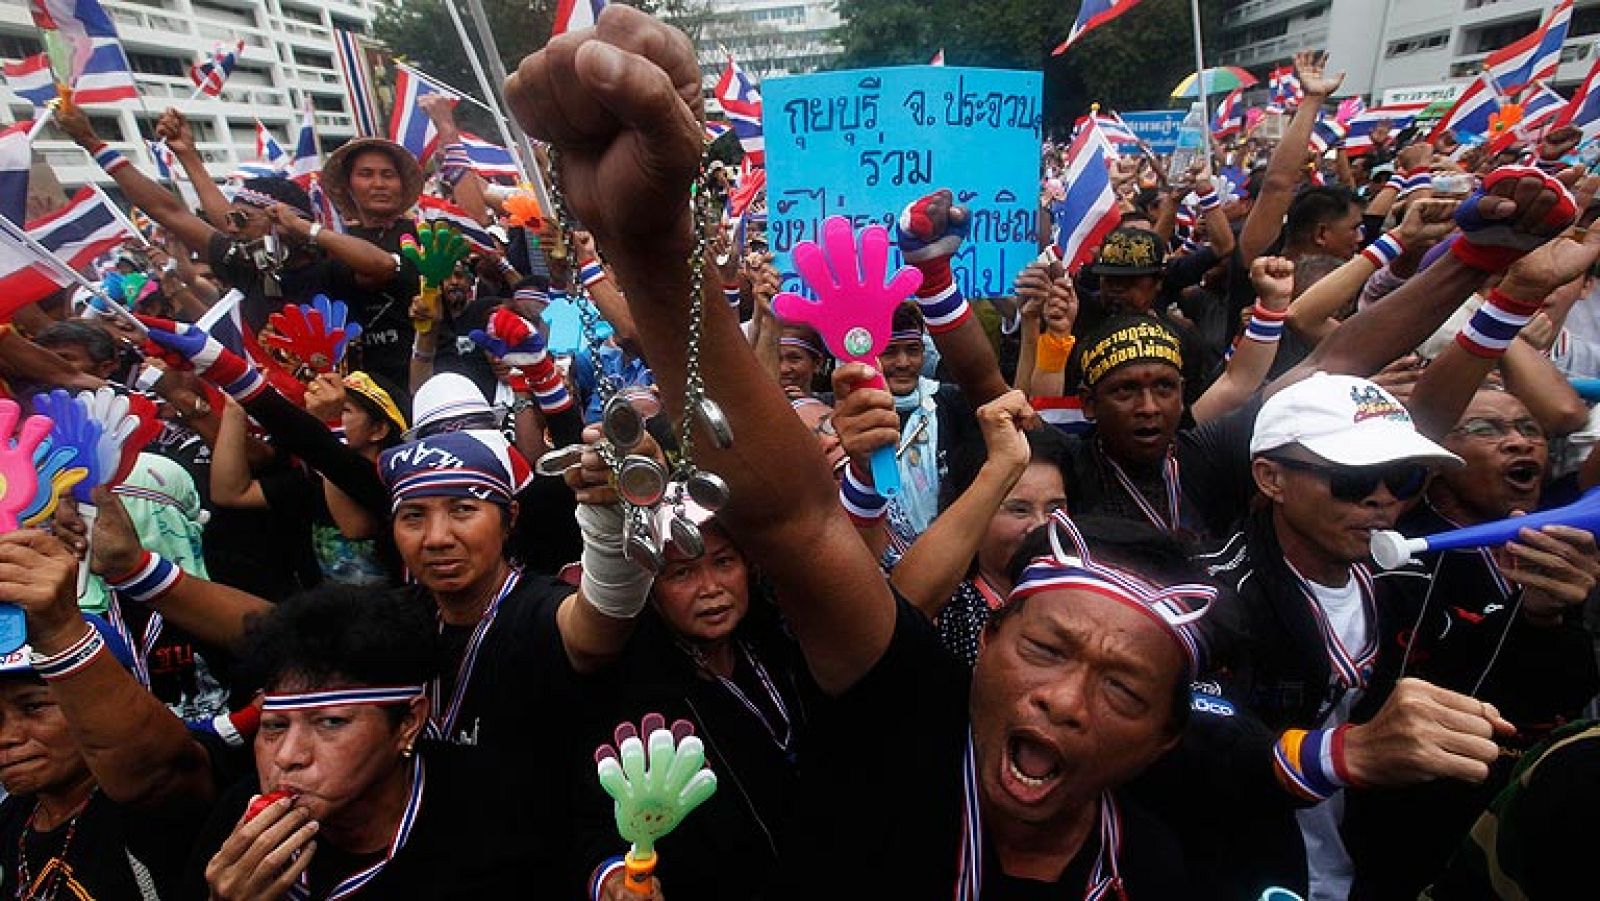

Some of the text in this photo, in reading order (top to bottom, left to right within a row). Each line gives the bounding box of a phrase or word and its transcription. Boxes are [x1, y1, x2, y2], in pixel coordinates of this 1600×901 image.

[784, 75, 882, 149] กุยบุรี
[903, 89, 936, 127] จ.
[859, 131, 933, 187] ร่วม
